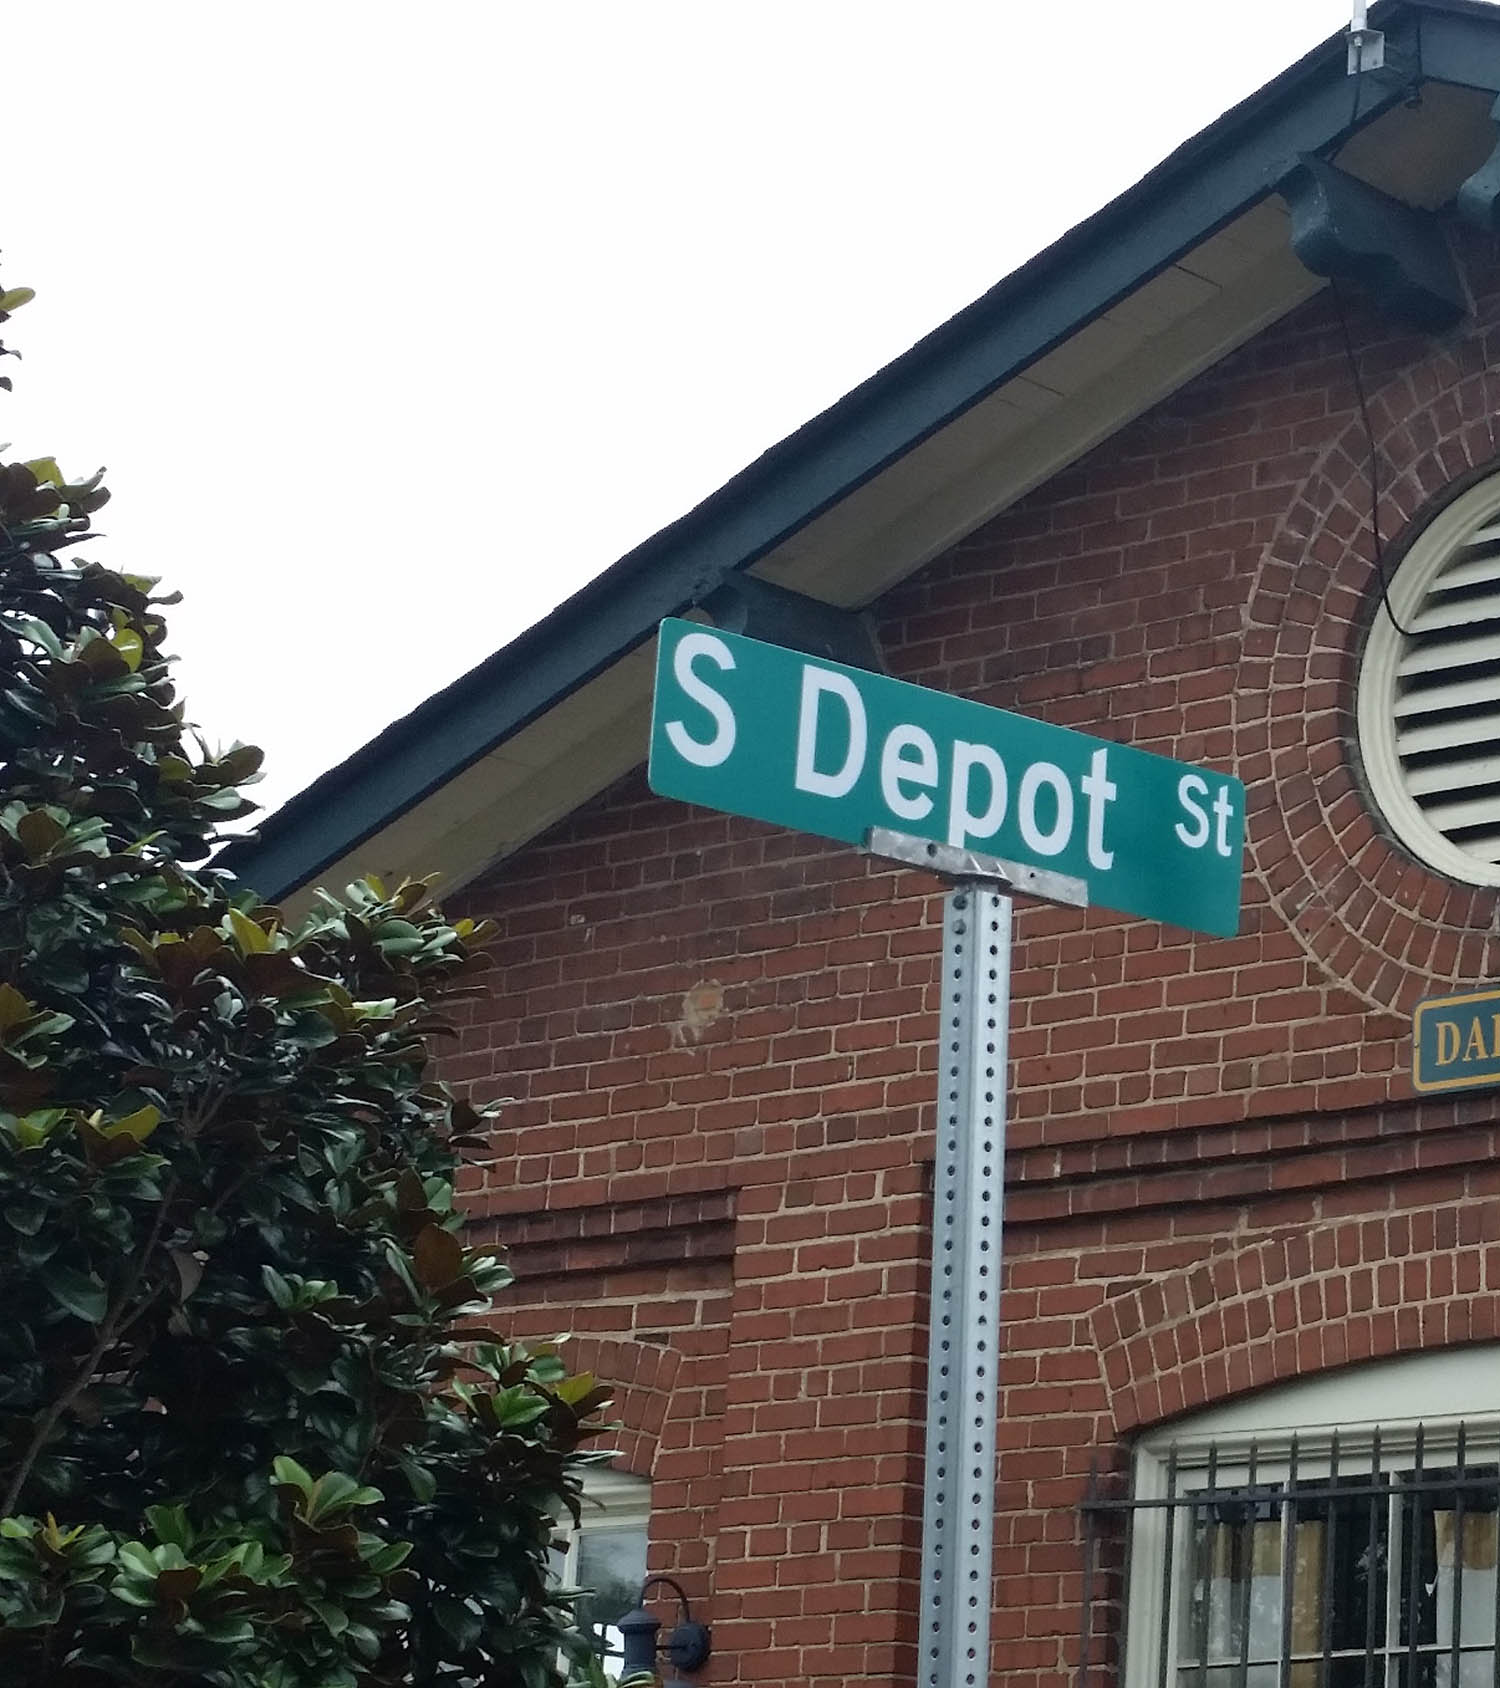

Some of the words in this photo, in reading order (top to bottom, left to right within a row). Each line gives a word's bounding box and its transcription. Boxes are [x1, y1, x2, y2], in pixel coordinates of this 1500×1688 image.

[664, 632, 737, 768] S
[795, 664, 1117, 870] Depot
[1174, 773, 1234, 857] St
